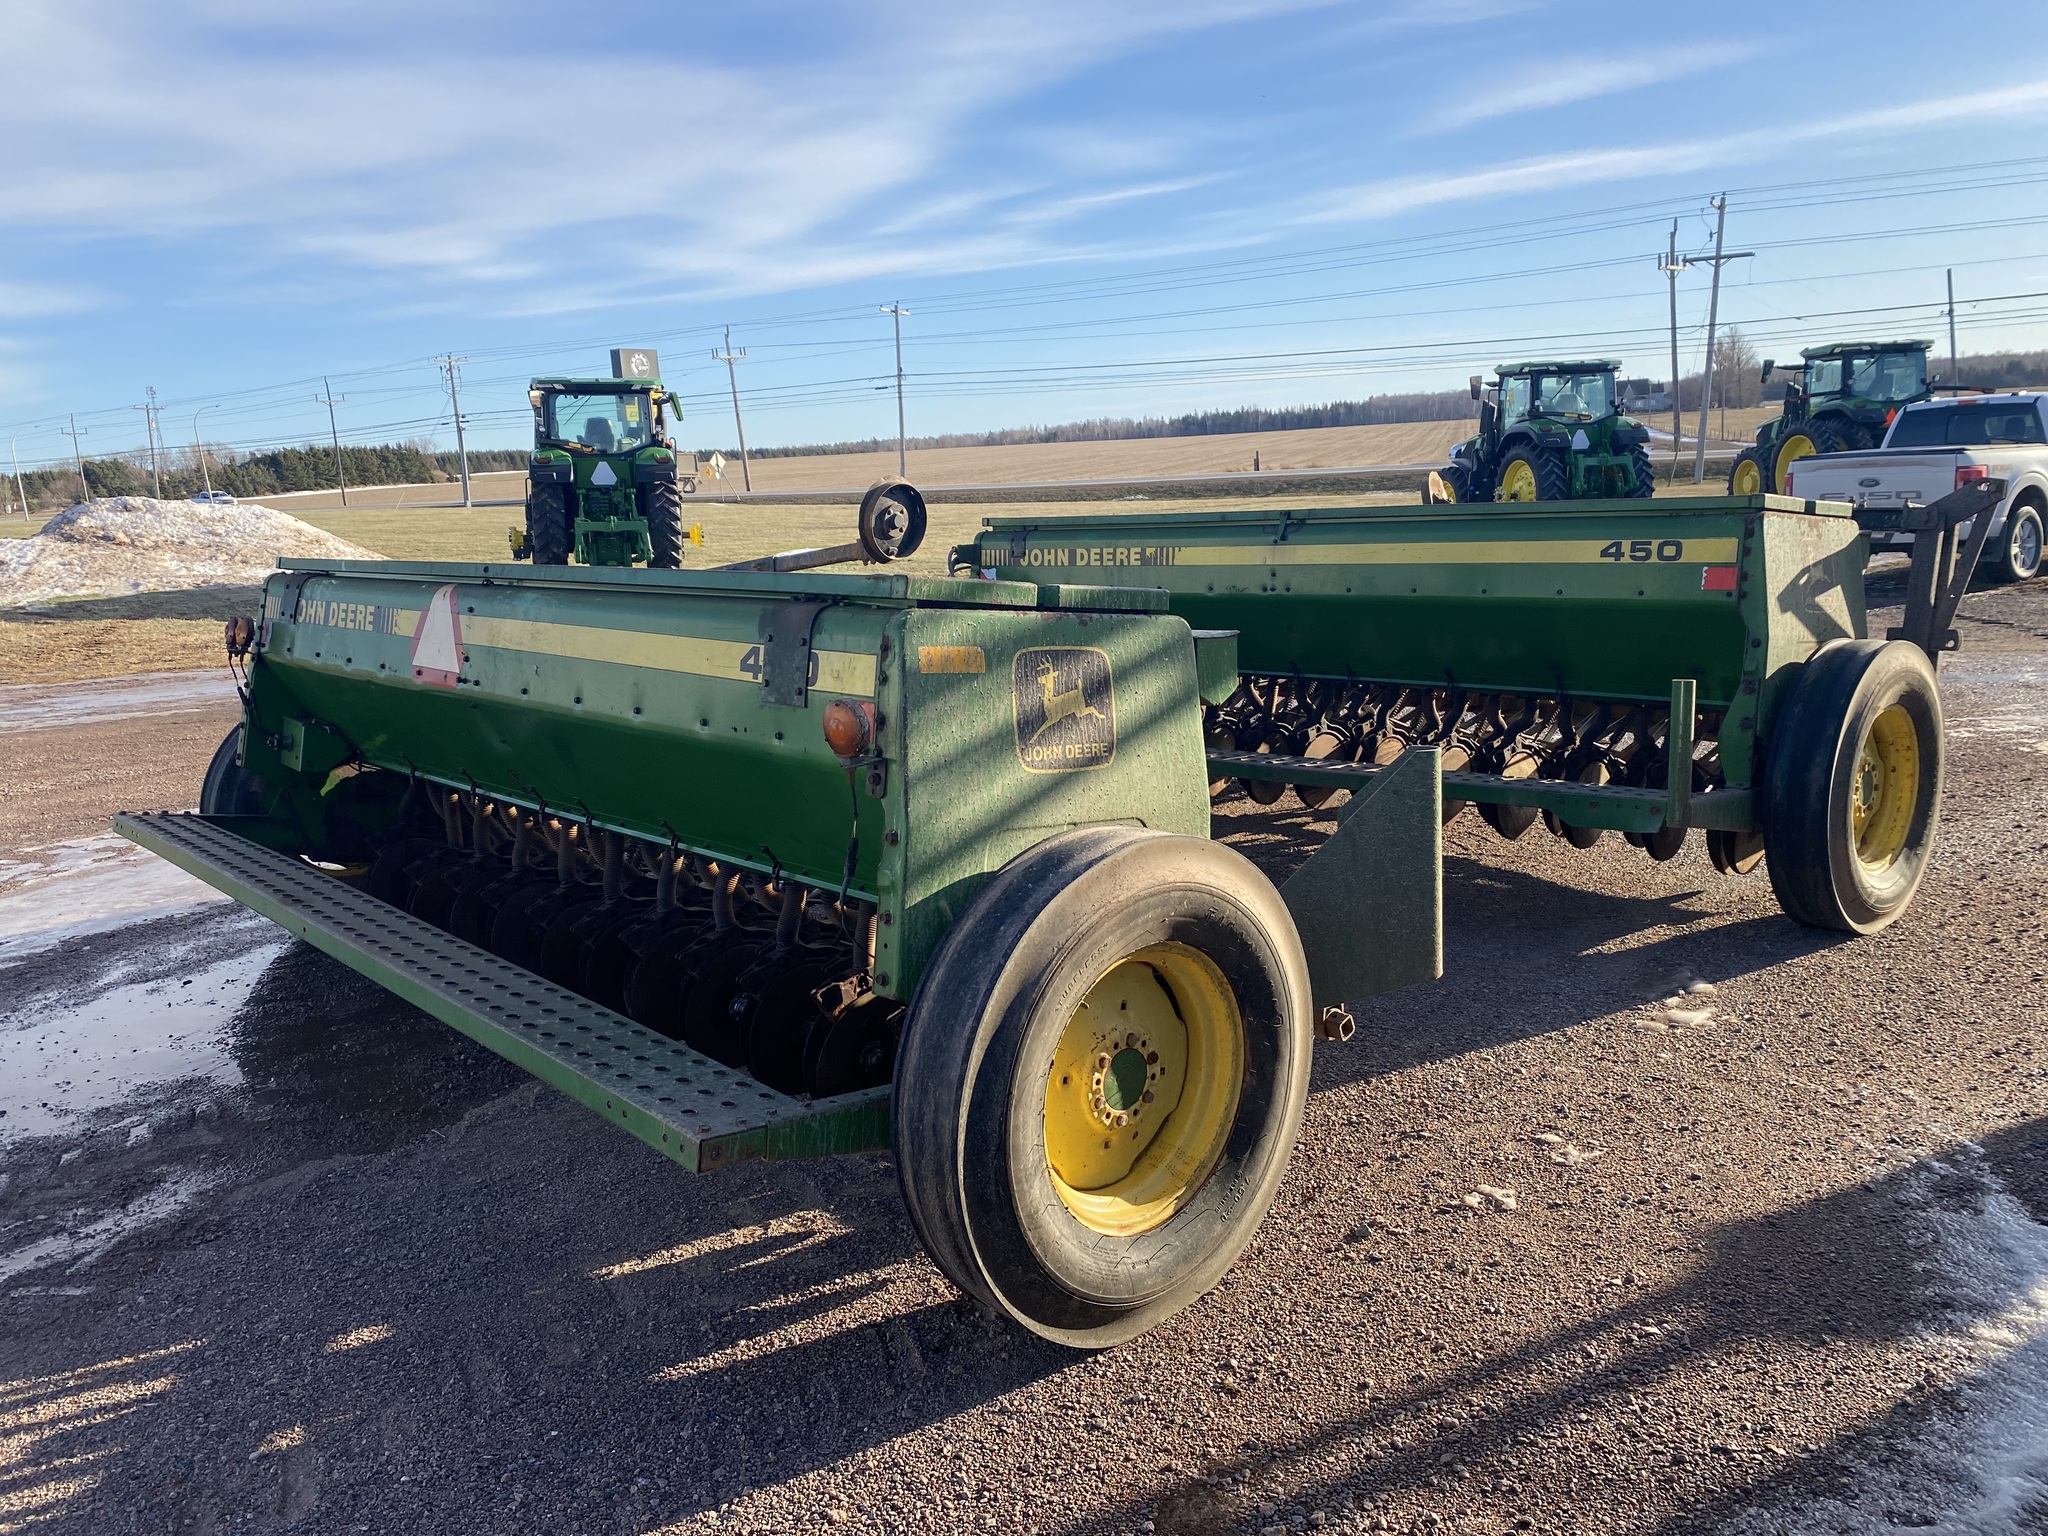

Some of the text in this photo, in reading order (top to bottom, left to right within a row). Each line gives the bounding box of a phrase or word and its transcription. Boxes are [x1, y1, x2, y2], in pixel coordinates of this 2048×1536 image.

[1820, 491, 1922, 501] F150
[1020, 547, 1142, 567] JOHN DEERE
[1600, 540, 1683, 562] 450
[297, 597, 375, 631] OHN DEERE
[1025, 742, 1109, 762] JOHN DEERE
